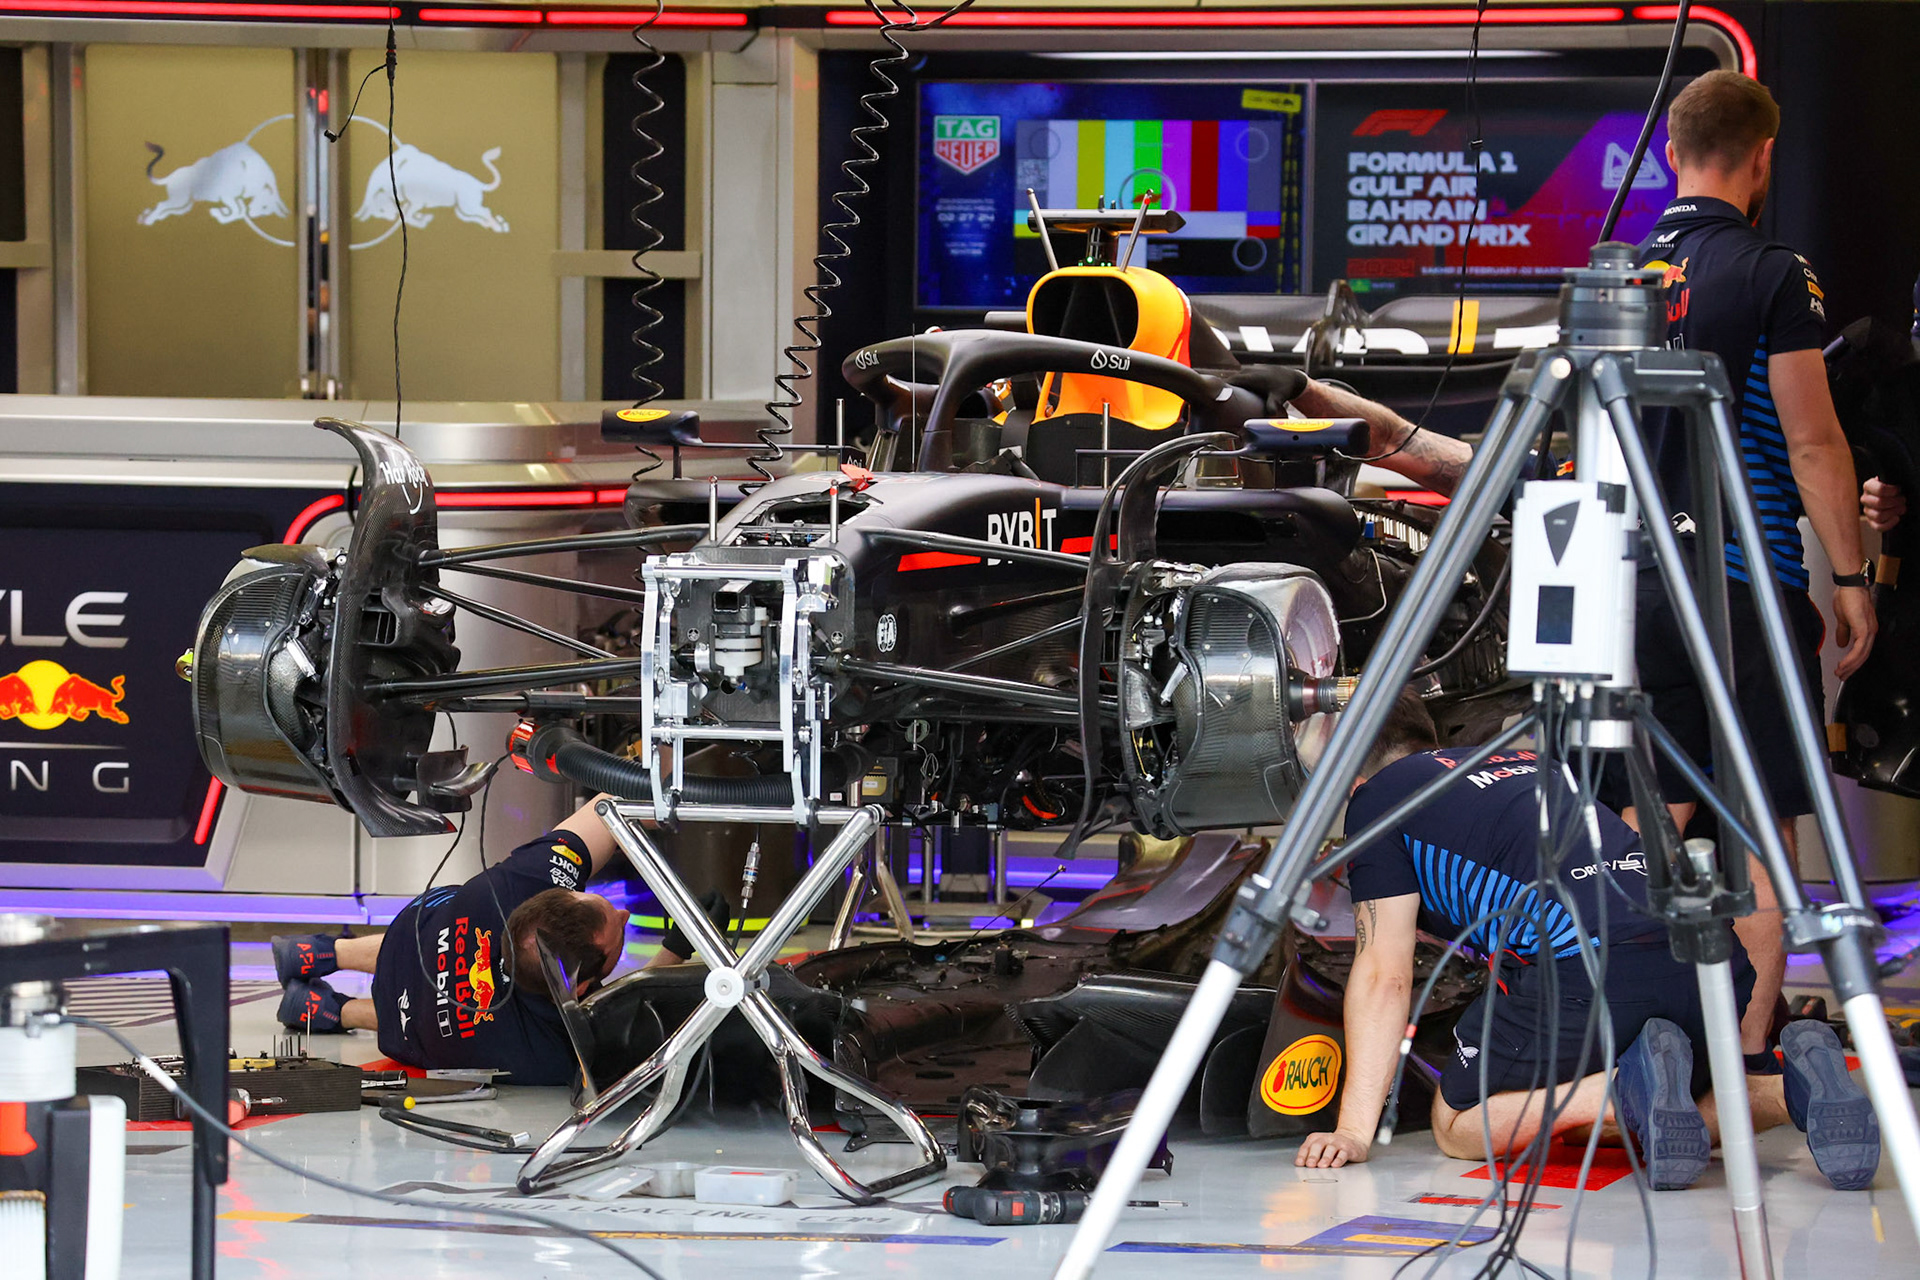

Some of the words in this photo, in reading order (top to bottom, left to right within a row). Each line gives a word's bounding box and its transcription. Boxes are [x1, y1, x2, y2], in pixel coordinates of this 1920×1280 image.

[940, 120, 994, 137] TAG
[938, 142, 995, 168] HEUER
[1349, 151, 1497, 174] FORMULA
[1501, 151, 1518, 173] 1
[1348, 175, 1424, 197] GULF
[1426, 175, 1478, 198] AIR
[1348, 199, 1488, 222] BAHRAIN
[1664, 204, 1698, 217] HONDA
[1347, 223, 1455, 247] GRAND
[1458, 223, 1532, 247] PRIX
[1108, 354, 1131, 371] Sui
[0, 589, 129, 648] LE
[455, 916, 470, 976] Red
[437, 926, 450, 1006] Mobil
[455, 980, 476, 1039] Bull
[1283, 1056, 1332, 1091] RAUCH
